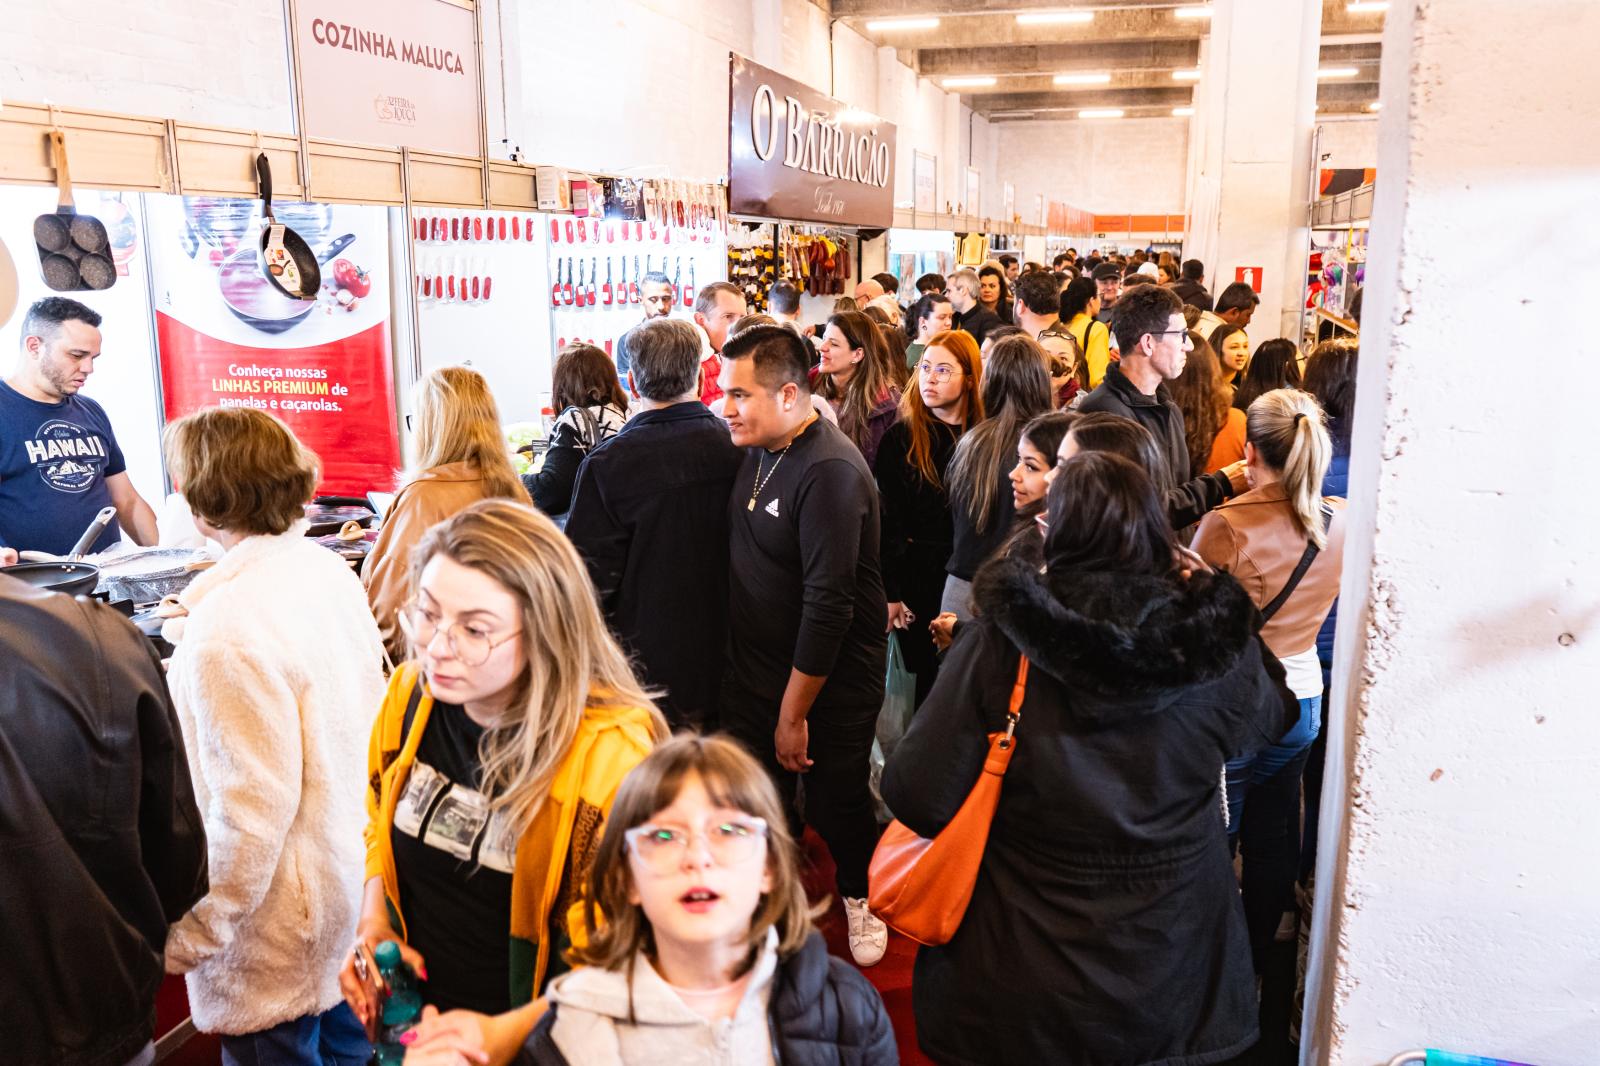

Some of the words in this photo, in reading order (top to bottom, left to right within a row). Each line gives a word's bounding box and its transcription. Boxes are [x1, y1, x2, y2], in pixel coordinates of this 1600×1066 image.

[312, 18, 398, 60] COZINHA
[402, 40, 465, 75] MALUCA
[751, 84, 779, 161] O
[783, 95, 890, 188] BARRACÃO
[228, 364, 283, 381] Conheça
[285, 367, 327, 379] nossas
[212, 378, 261, 393] LINHAS
[263, 381, 329, 395] PREMIUM
[331, 383, 348, 396] de
[220, 396, 268, 409] panelas
[270, 399, 278, 409] e
[280, 398, 342, 414] caçarolas.
[24, 436, 105, 464] HAWAII
